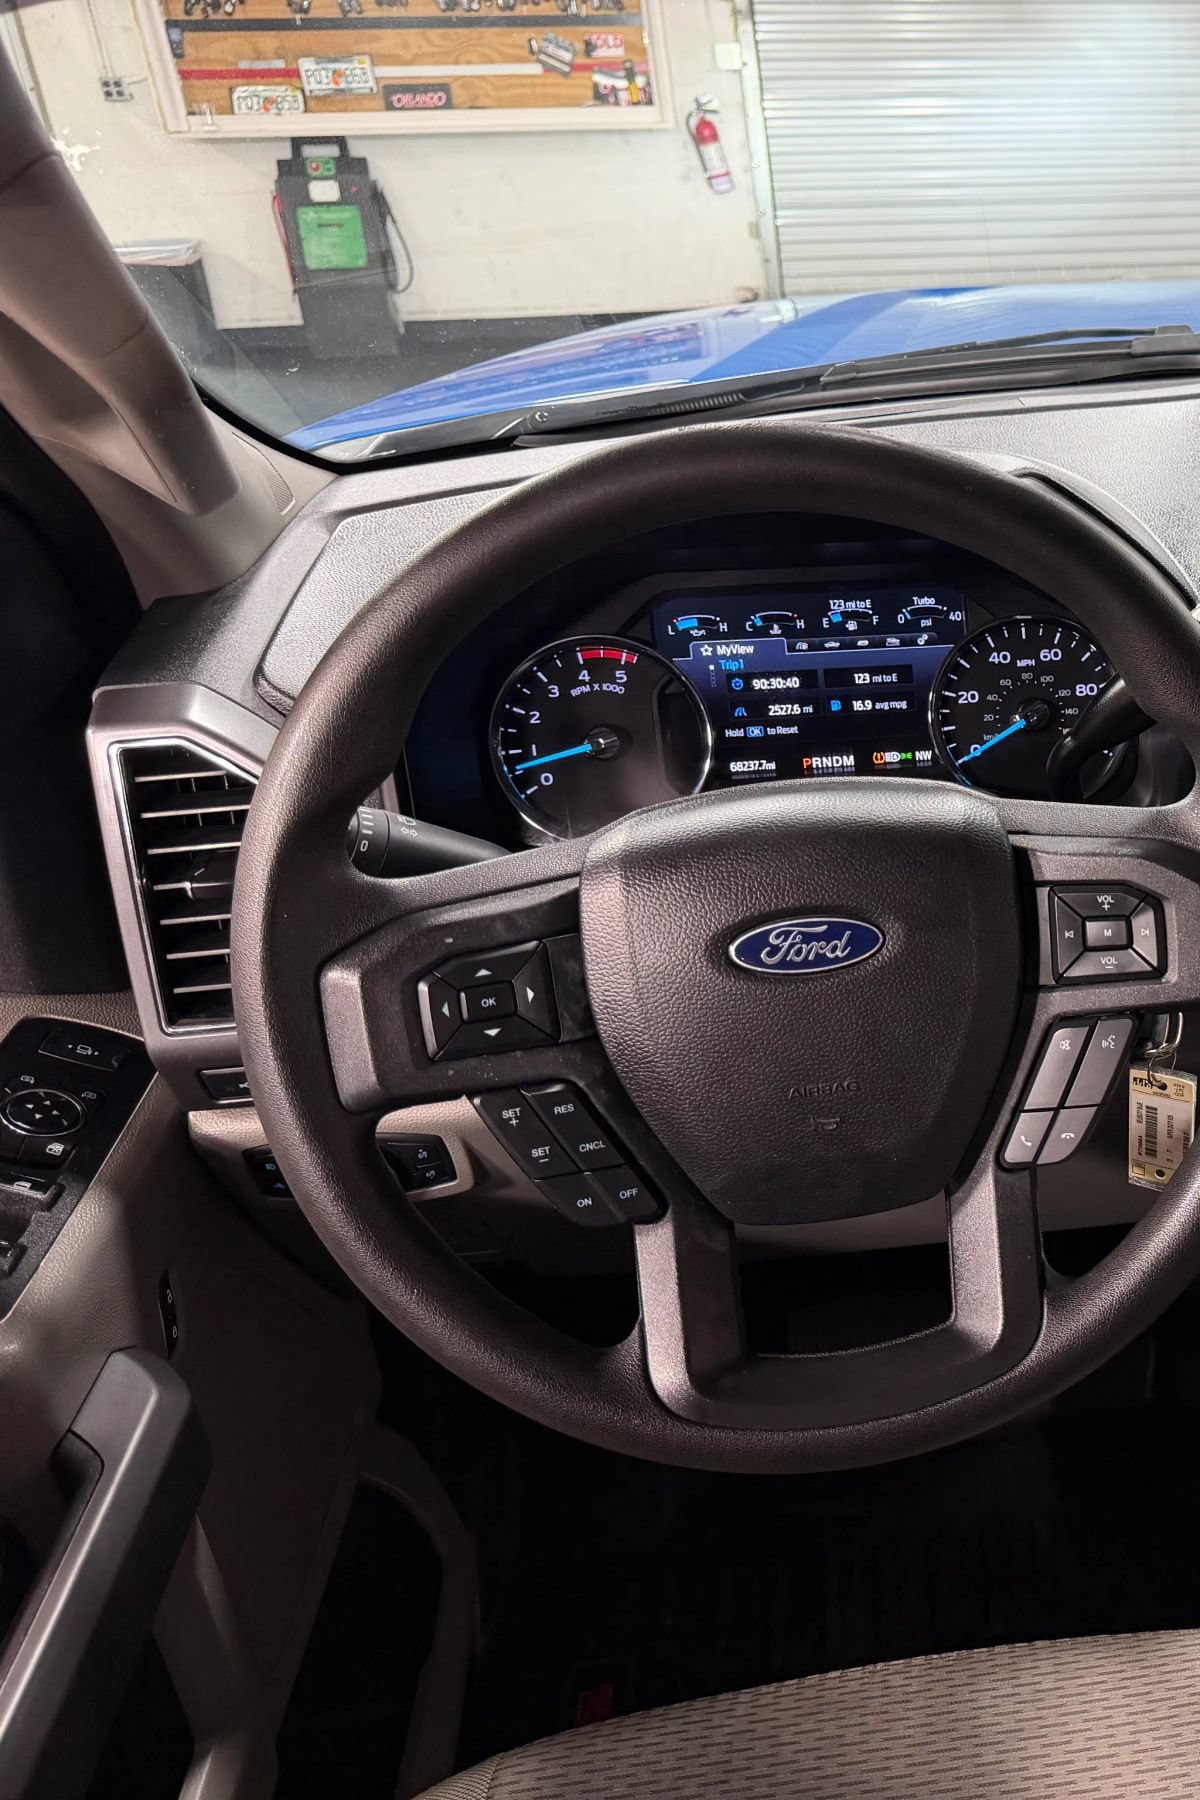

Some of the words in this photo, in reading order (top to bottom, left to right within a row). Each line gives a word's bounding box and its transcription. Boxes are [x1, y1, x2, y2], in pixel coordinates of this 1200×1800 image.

[391, 91, 447, 106] ORLANDO
[829, 599, 845, 610] 123
[846, 600, 854, 609] mi
[855, 599, 864, 608] to
[865, 598, 872, 608] E
[912, 596, 936, 606] Turbo
[873, 615, 880, 626] F
[897, 614, 905, 625] 0
[948, 610, 962, 622] 40
[719, 621, 728, 632] H
[745, 621, 754, 632] C
[796, 619, 805, 629] H
[822, 617, 829, 629] E
[920, 617, 933, 628] psi
[668, 624, 676, 636] L
[716, 643, 754, 656] MyView
[1039, 649, 1062, 661] 60
[989, 651, 1011, 664] 40
[1016, 658, 1035, 668] MPH
[578, 670, 591, 682] 4
[615, 670, 628, 683] 5
[854, 672, 870, 684] 123
[872, 674, 882, 683] mi
[883, 674, 891, 683] to
[891, 673, 898, 683] E
[1022, 672, 1033, 680] 80
[1040, 675, 1054, 683] 100
[752, 676, 800, 689] 90:30:40
[1000, 679, 1012, 687] 60
[548, 685, 560, 698] 3
[570, 684, 591, 697] RPM
[602, 683, 625, 694] 1000
[1058, 689, 1071, 697] 120
[1075, 684, 1098, 696] 80
[958, 690, 979, 704] 20
[768, 703, 801, 716] 2527.6
[802, 704, 813, 714] mi
[852, 700, 872, 711] 16.9
[874, 701, 889, 712] avg
[890, 700, 908, 712] mpg
[529, 711, 542, 724] 2
[725, 727, 744, 738] Hold
[749, 726, 762, 737] OK
[767, 726, 776, 736] to
[777, 726, 799, 736] Reset
[531, 744, 537, 757] 1
[915, 750, 933, 761] NW
[802, 755, 855, 769] PRNDM
[540, 773, 554, 786] 0
[1096, 895, 1115, 903] VOL
[1104, 928, 1112, 937] M
[760, 924, 852, 965] Ford
[1100, 956, 1118, 965] VOL
[481, 996, 496, 1008] OK
[788, 1080, 861, 1100] AIRBAG
[502, 1107, 522, 1119] SET
[554, 1103, 575, 1114] RES
[531, 1146, 550, 1158] SET
[579, 1140, 606, 1153] CNCL
[619, 1188, 639, 1199] OFF
[576, 1197, 592, 1208] ON
